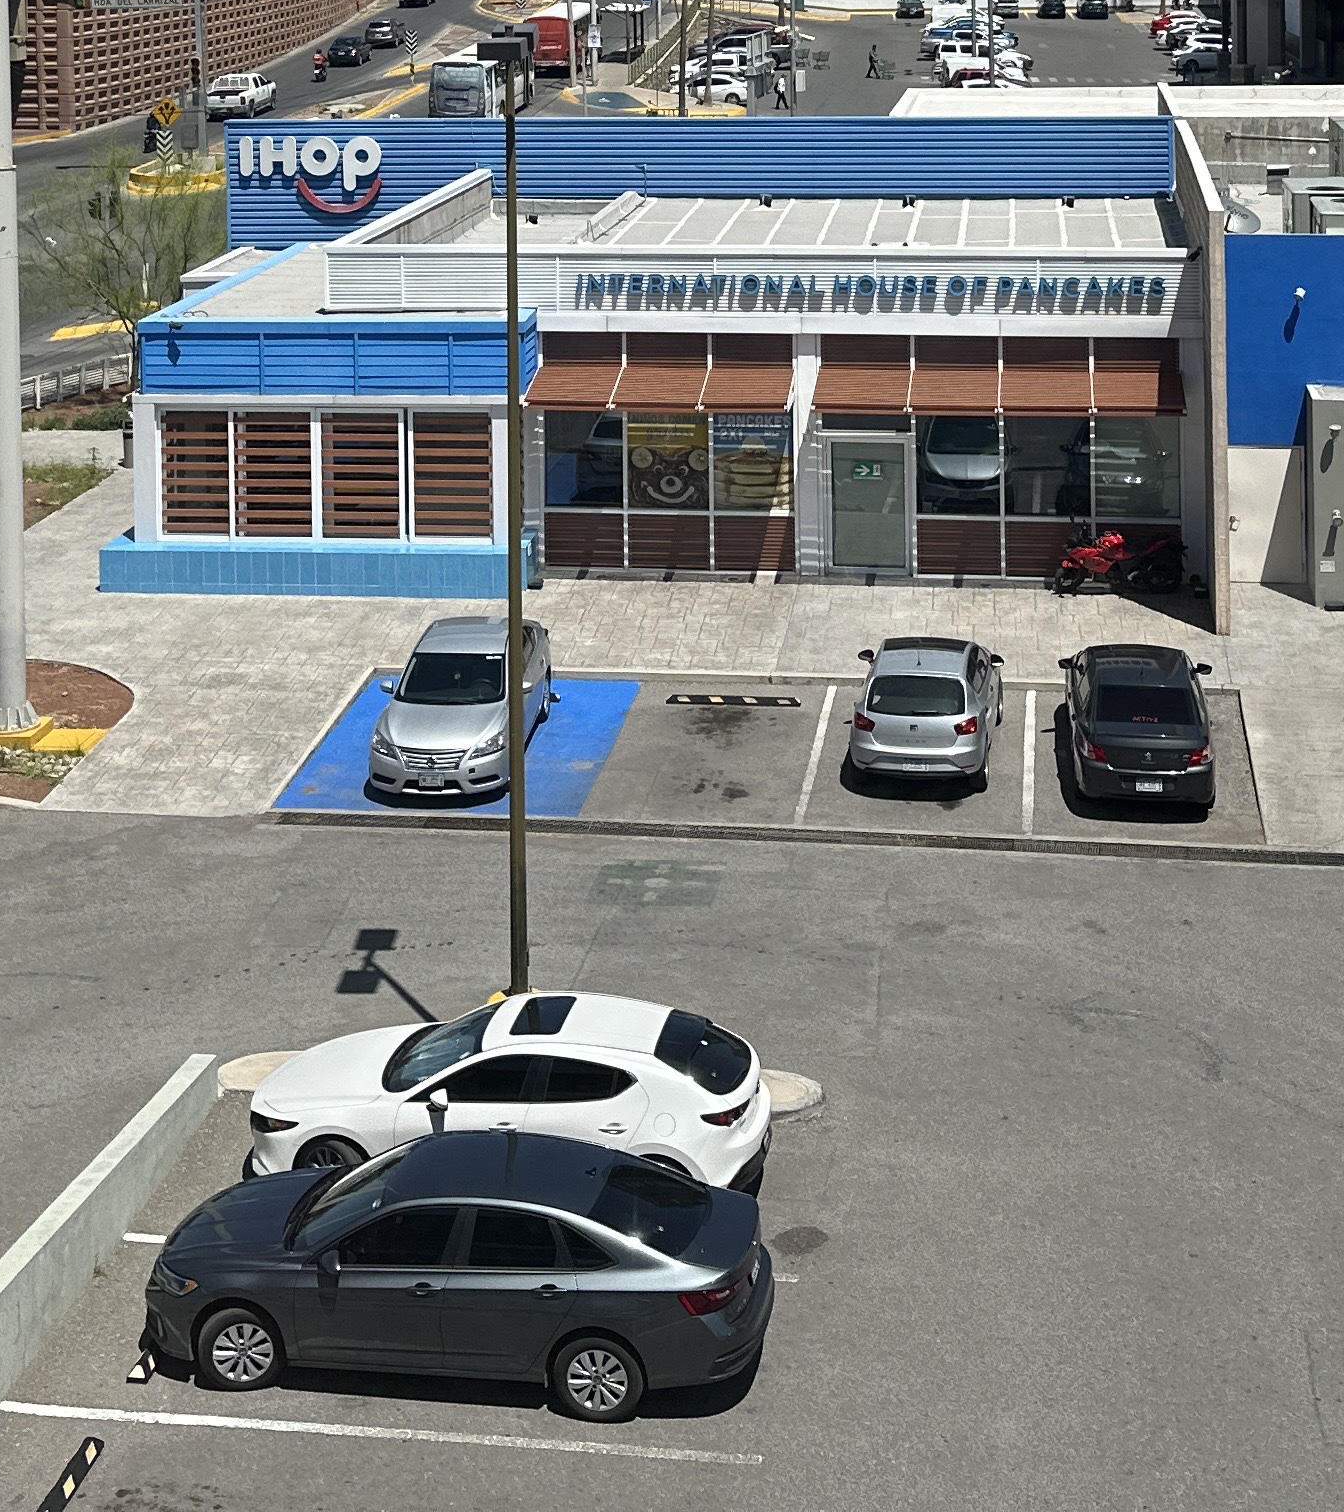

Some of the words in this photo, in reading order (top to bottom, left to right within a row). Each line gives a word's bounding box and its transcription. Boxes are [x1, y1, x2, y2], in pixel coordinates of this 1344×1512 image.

[239, 136, 382, 192] IHOP
[576, 273, 824, 295] INTERNATIONAL
[833, 274, 937, 297] HOUSE
[947, 274, 989, 297] OF
[998, 276, 1167, 298] PANCAKES
